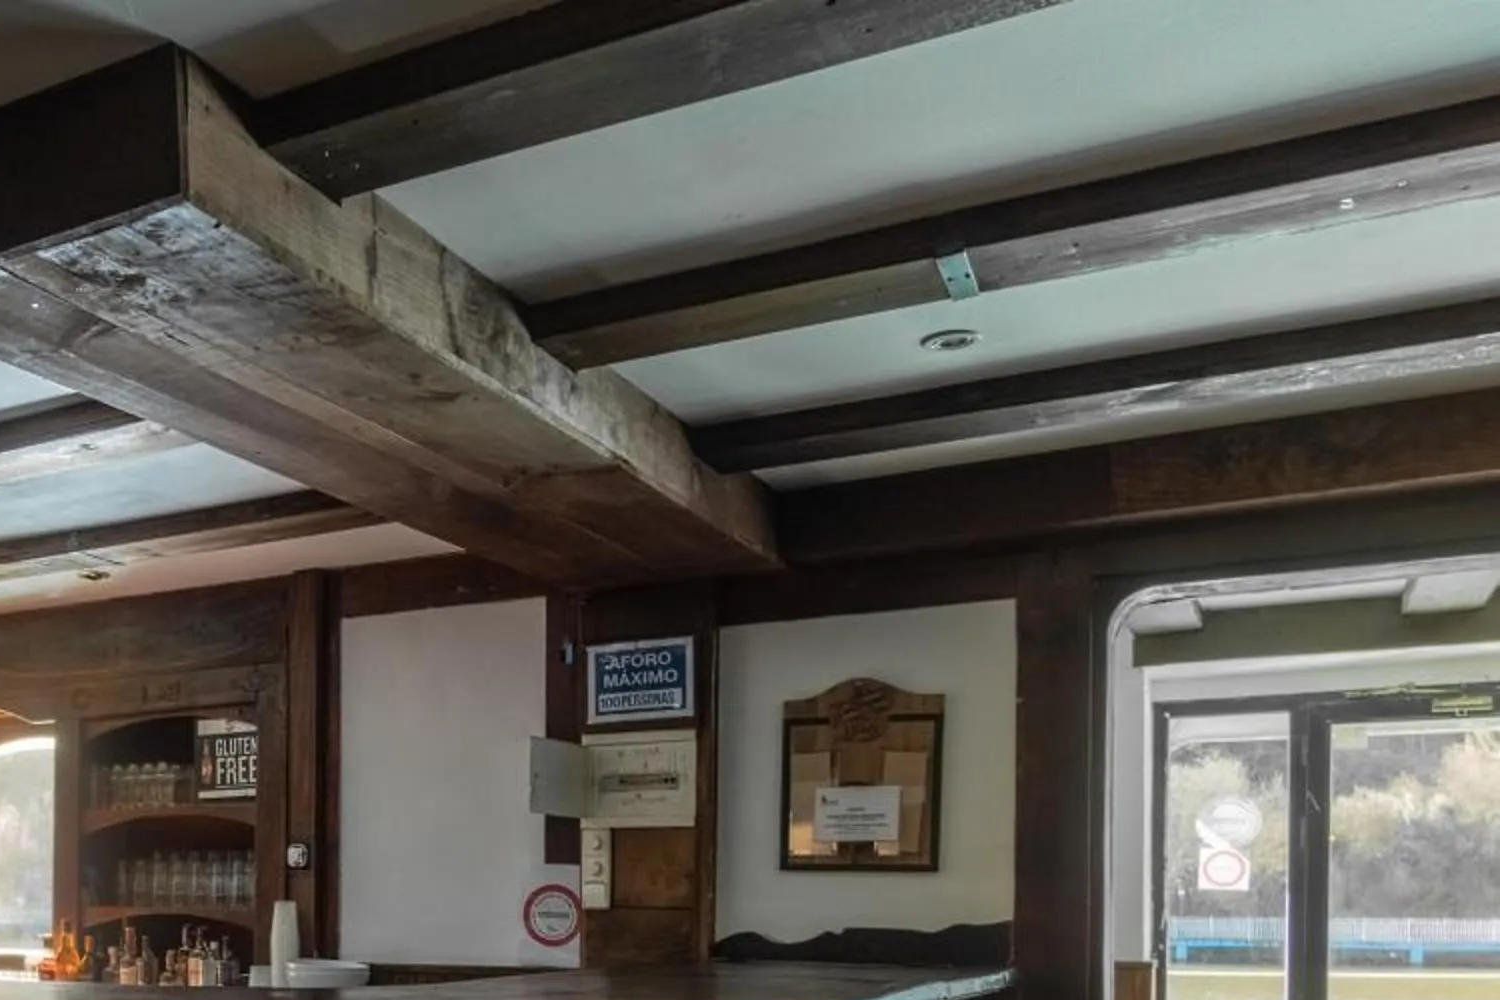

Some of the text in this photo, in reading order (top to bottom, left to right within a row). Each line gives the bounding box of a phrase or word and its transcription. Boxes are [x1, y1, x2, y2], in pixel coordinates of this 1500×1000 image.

[603, 668, 678, 689] MÁXIMO
[215, 735, 257, 756] GLUTEN
[215, 755, 256, 785] FREE
